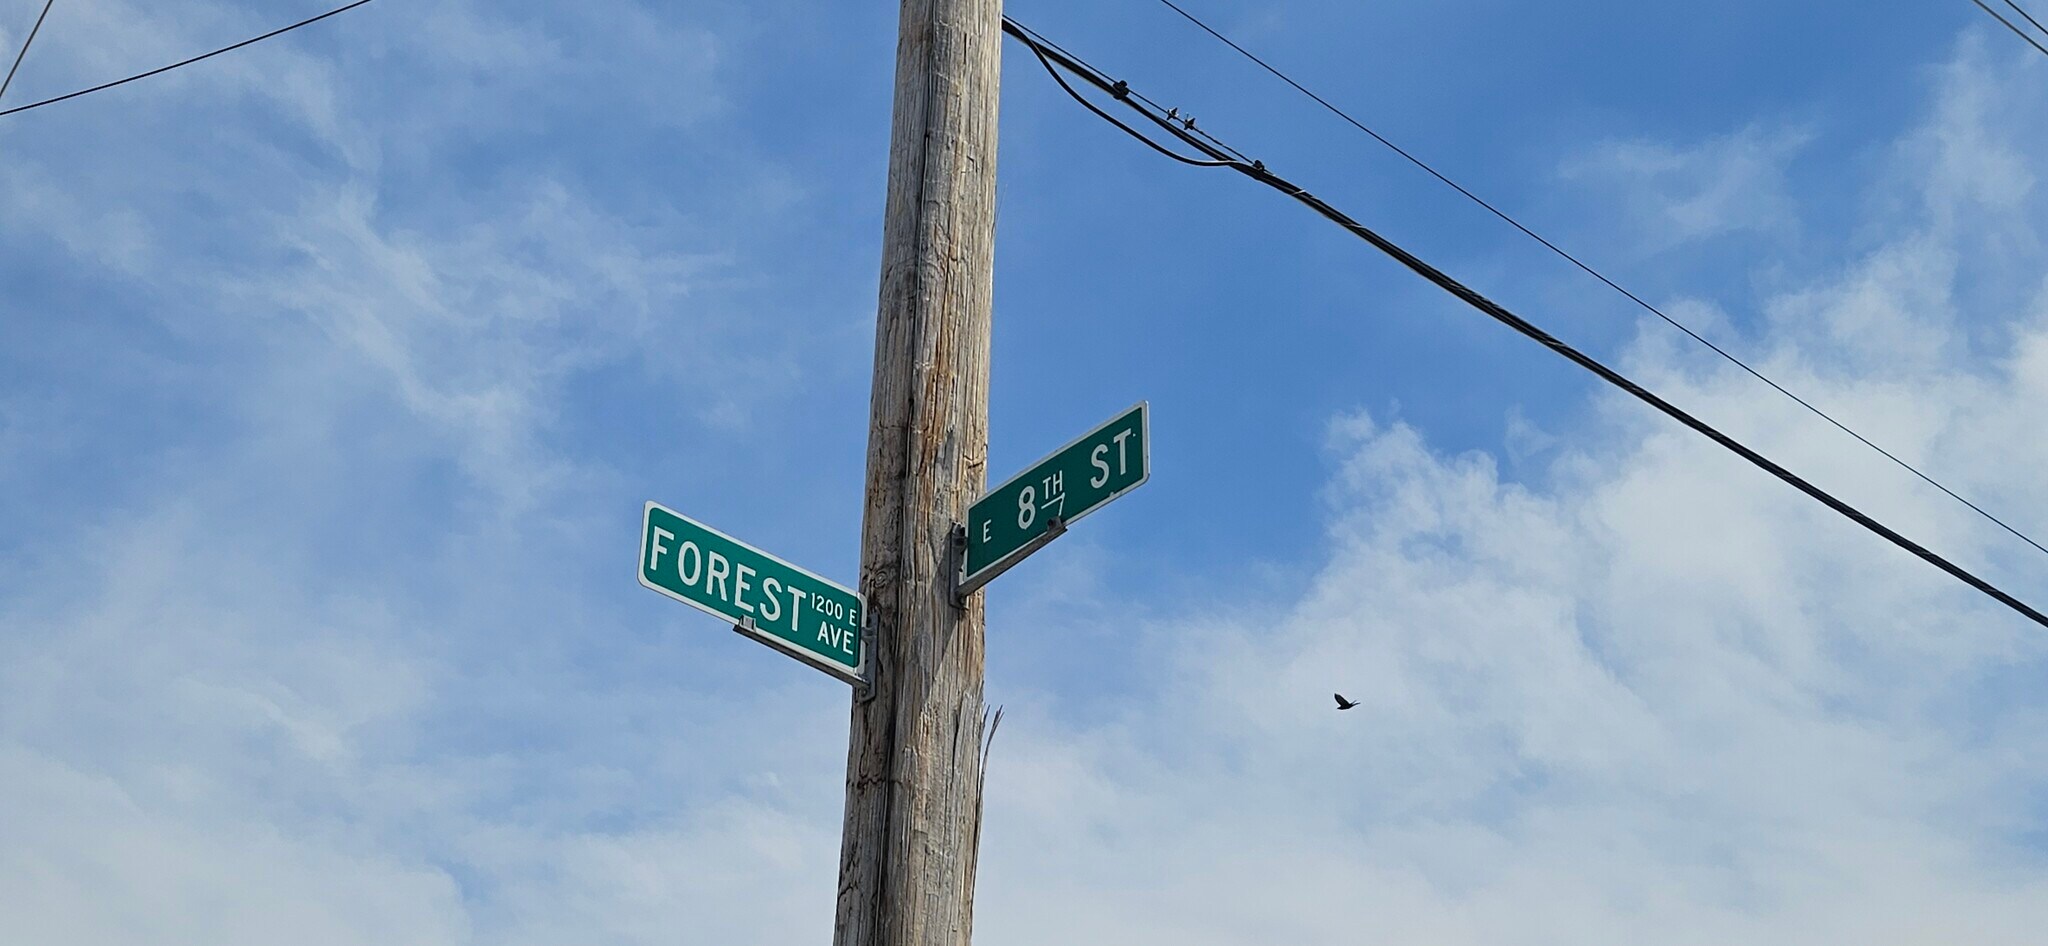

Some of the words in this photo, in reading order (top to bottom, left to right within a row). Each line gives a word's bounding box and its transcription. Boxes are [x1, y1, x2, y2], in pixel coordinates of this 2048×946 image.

[983, 519, 992, 543] E
[1090, 428, 1132, 489] ST
[650, 525, 807, 632] FOREST
[817, 621, 854, 655] AVE
[811, 592, 843, 620] 1200
[849, 608, 857, 627] E
